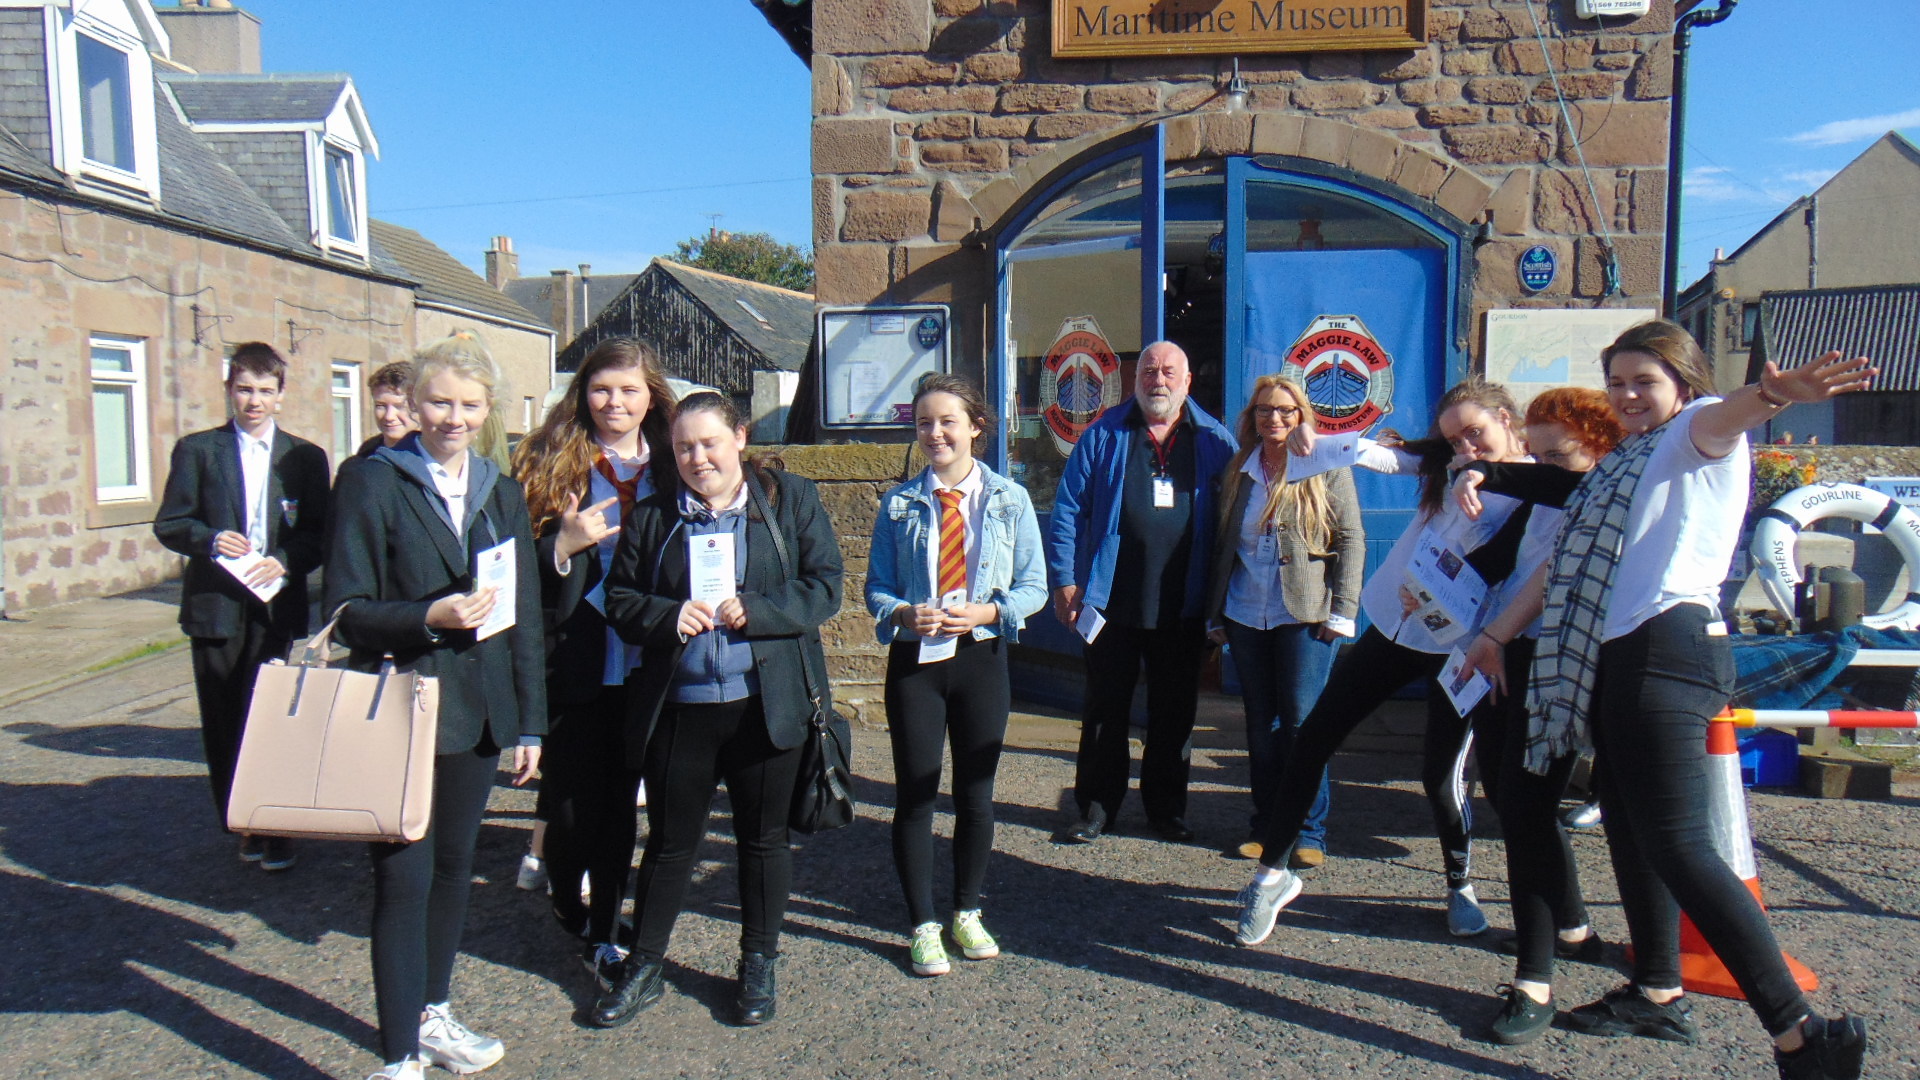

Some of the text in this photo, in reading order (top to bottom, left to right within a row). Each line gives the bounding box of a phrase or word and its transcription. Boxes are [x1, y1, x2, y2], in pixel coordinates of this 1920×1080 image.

[1073, 0, 1405, 37] Maritime Museum
[1071, 323, 1087, 331] THE
[1050, 337, 1111, 367] MAGGIE LAW
[1296, 335, 1380, 365] MAGGIE LAW
[1338, 406, 1374, 430] MUSEUM
[1801, 490, 1863, 509] GOURLINE
